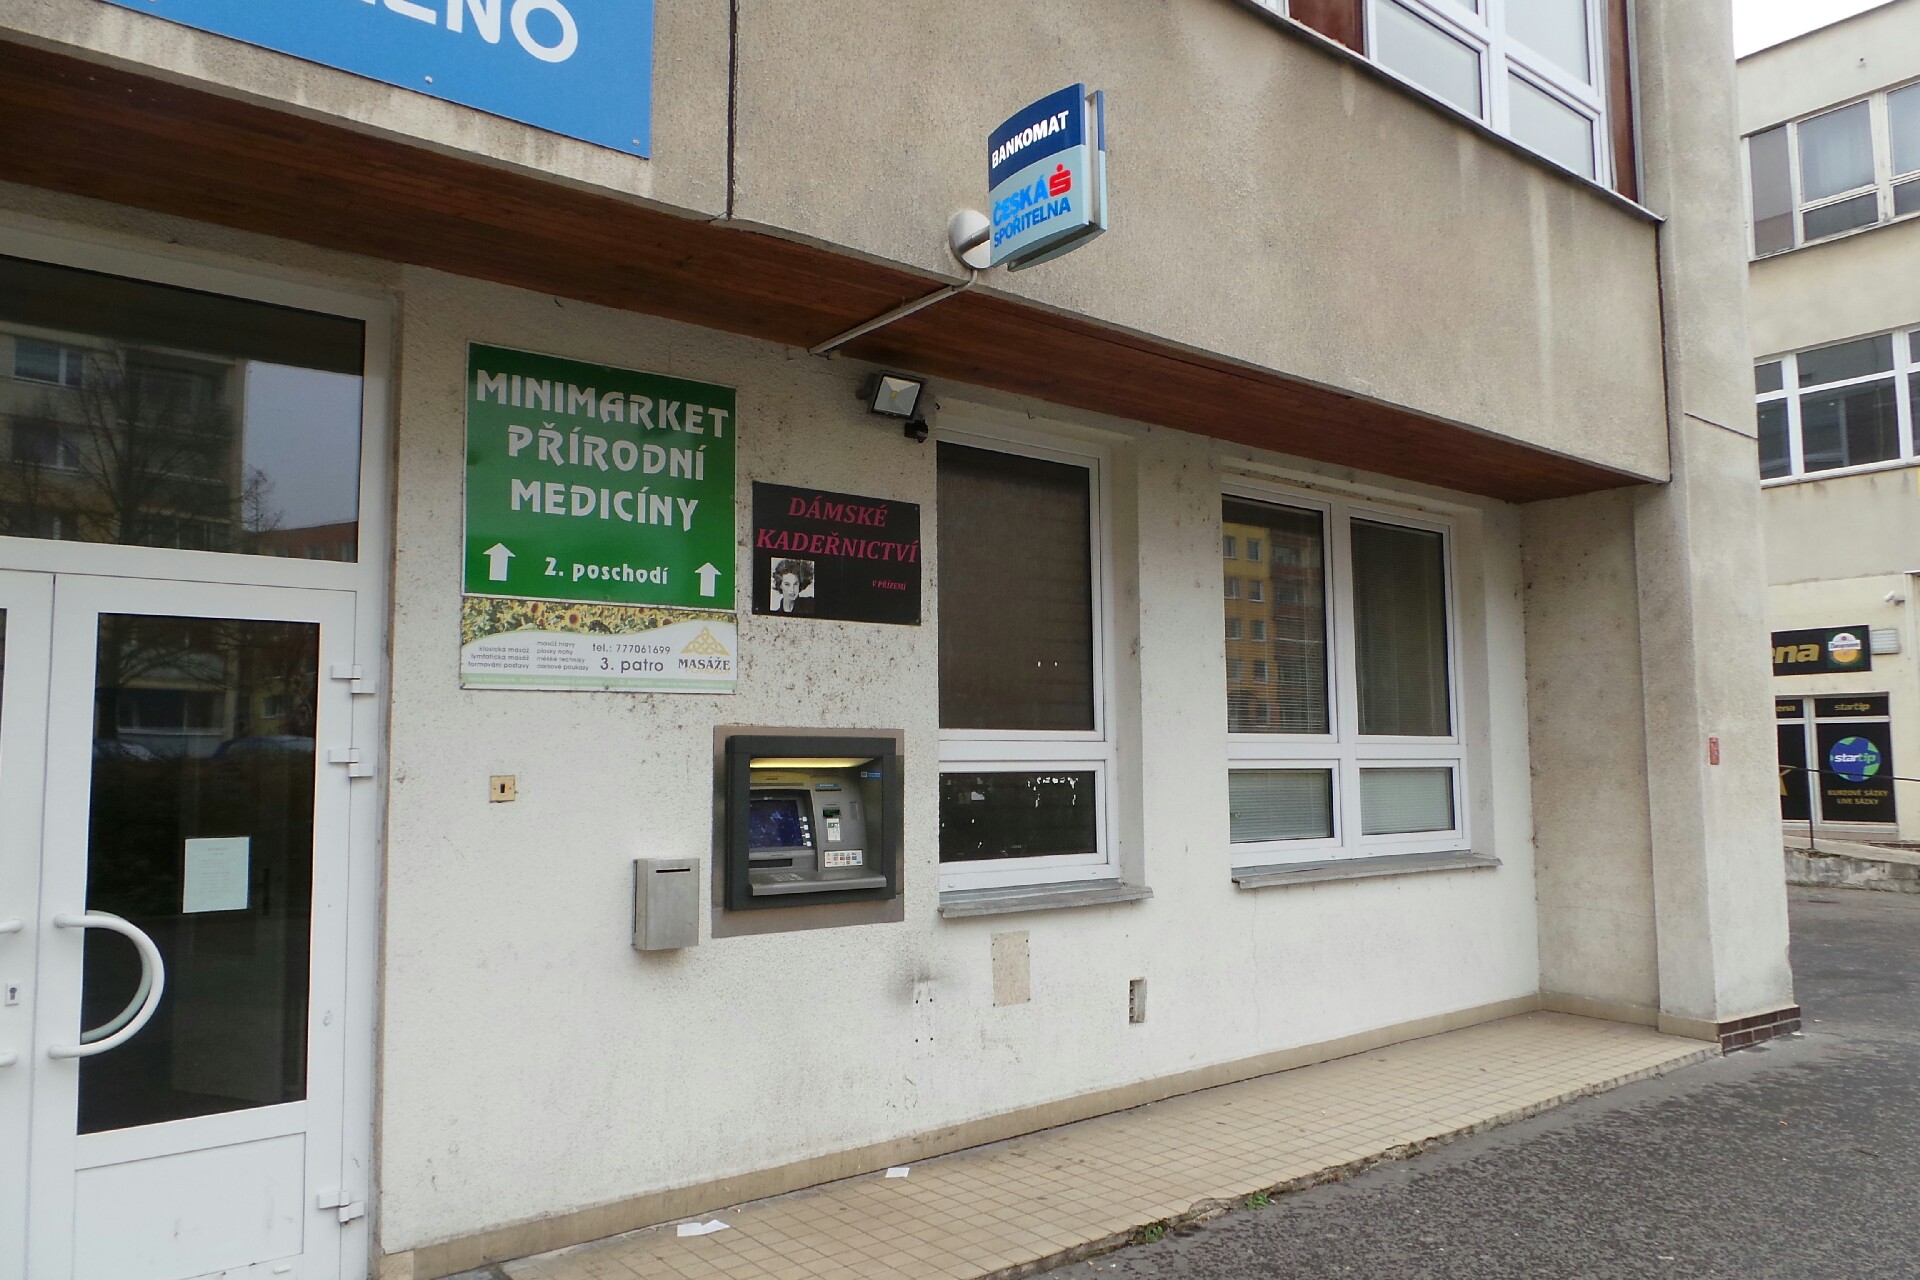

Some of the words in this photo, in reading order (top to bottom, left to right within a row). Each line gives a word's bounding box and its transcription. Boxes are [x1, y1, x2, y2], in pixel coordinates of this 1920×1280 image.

[991, 110, 1069, 170] BANKOMAT
[993, 174, 1050, 227] ČESKÁ
[993, 197, 1072, 248] SPOŘITELNA
[476, 369, 729, 439] MINIMARKET
[507, 422, 708, 481] PŘÍRODNÍ
[510, 478, 699, 532] MEDICÍNY
[788, 495, 888, 527] DÁMSKÉ
[756, 528, 920, 563] KADEŘNICTVÍ
[544, 557, 565, 577] 2.
[572, 563, 669, 585] poschodí
[600, 657, 614, 671] 3.
[620, 658, 664, 674] patro
[616, 644, 671, 655] 777061699
[678, 656, 731, 671] MASÁŽE
[1772, 643, 1820, 664] na
[1834, 702, 1871, 712] startip
[1834, 753, 1877, 764] startip
